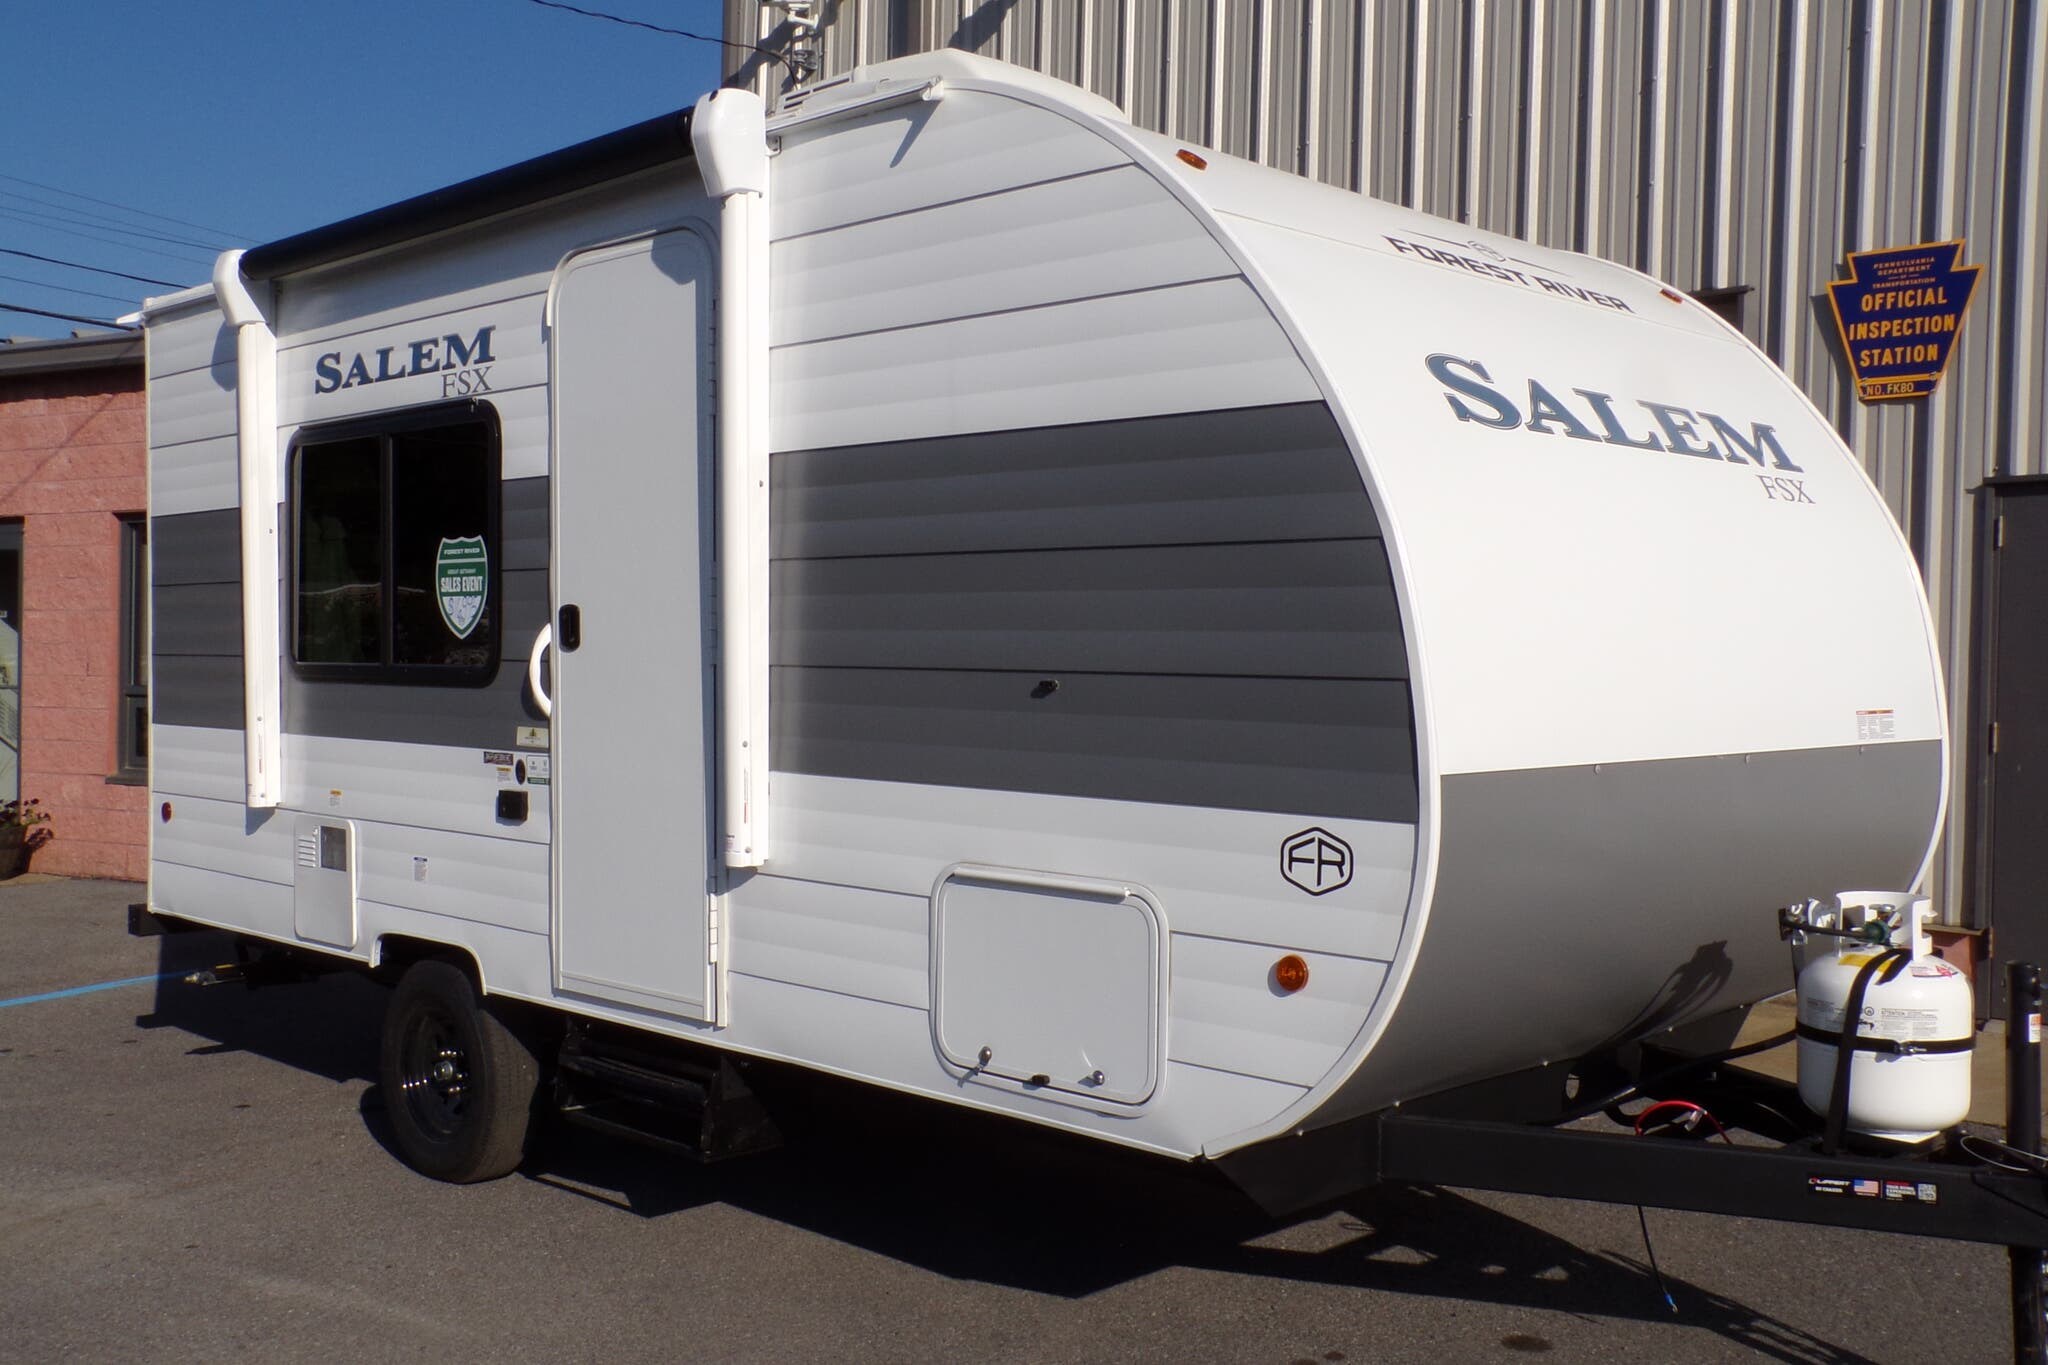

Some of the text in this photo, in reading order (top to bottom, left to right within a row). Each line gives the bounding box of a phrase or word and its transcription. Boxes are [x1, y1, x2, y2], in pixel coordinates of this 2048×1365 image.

[1381, 234, 1636, 314] FOREST RIVER
[1872, 277, 1936, 289] TRANSPORTATION
[1877, 265, 1931, 276] DEPARTMENT
[1861, 287, 1948, 312] OFFICIAL
[1849, 314, 1956, 341] INSPECTION
[315, 325, 496, 394] SALEM
[1860, 344, 1939, 368] STATION
[441, 366, 492, 398] FSX
[1425, 353, 1804, 473] SALEM
[1755, 474, 1816, 505] FSX
[440, 576, 483, 592] SALES EVENT
